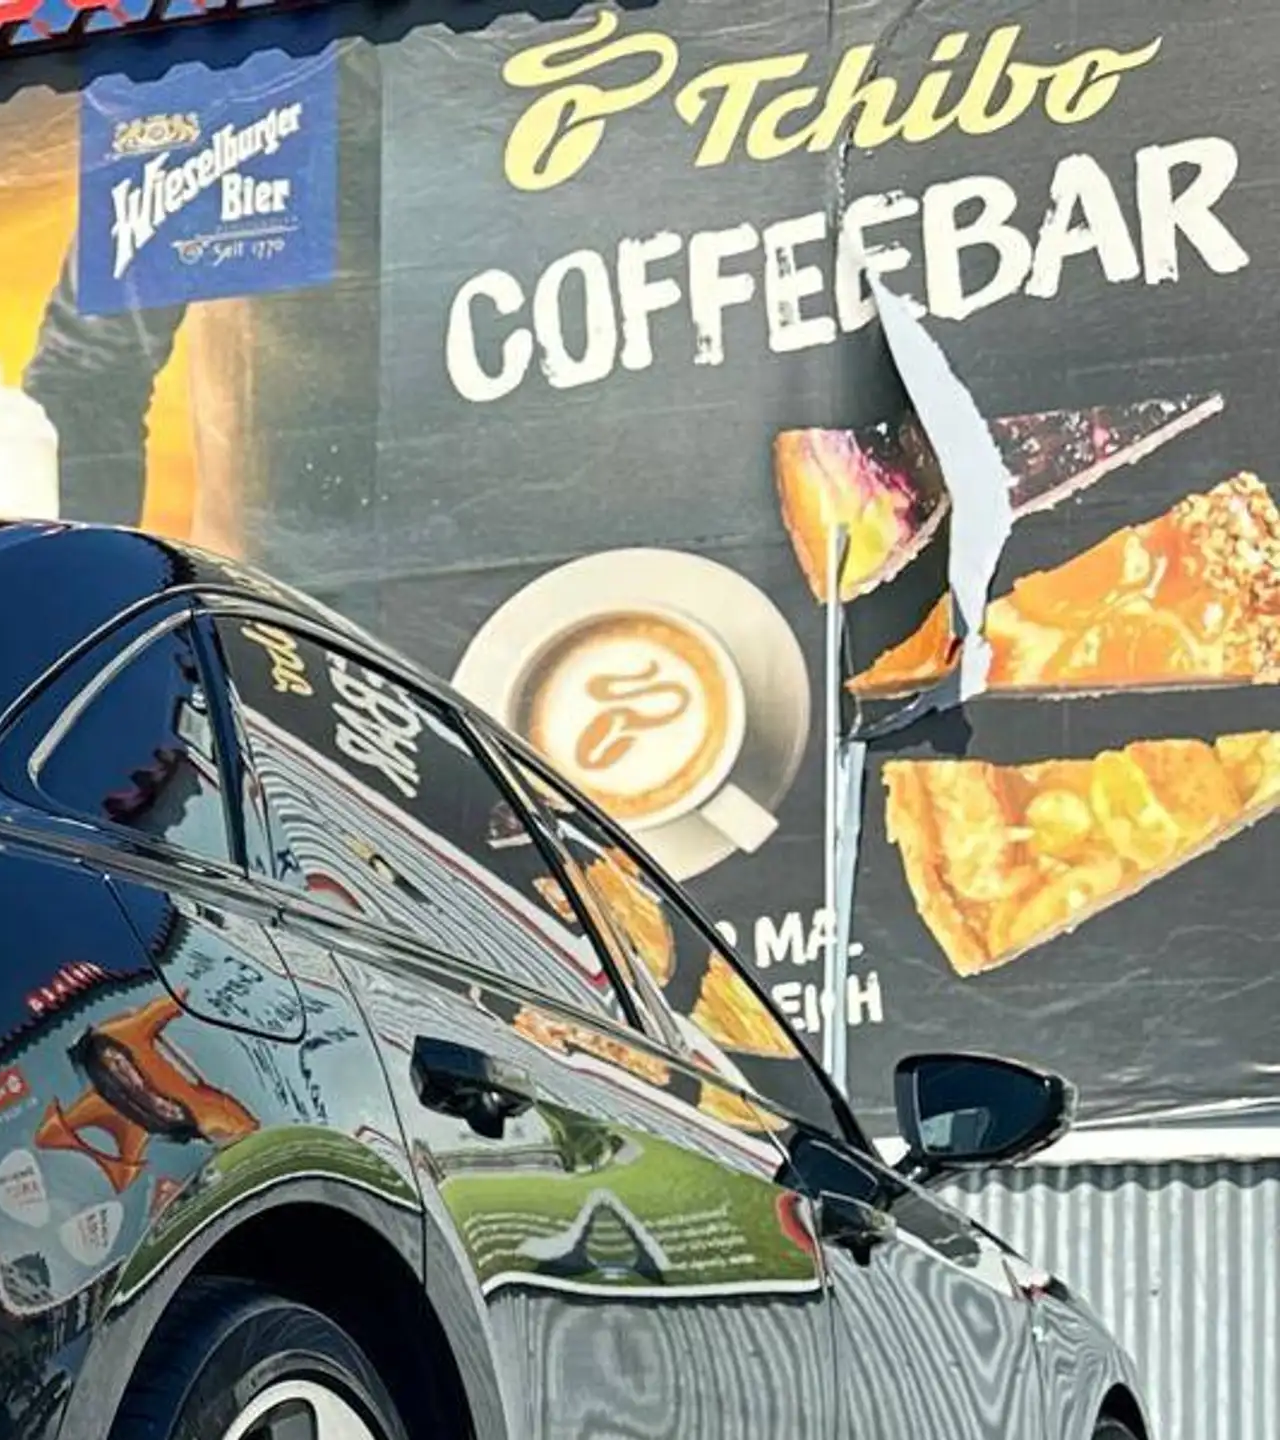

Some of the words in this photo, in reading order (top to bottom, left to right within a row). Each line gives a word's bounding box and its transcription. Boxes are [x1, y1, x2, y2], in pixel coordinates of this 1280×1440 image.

[676, 26, 1163, 168] Tchibo
[111, 102, 303, 280] Wieselburger
[220, 172, 290, 222] Bier
[446, 136, 1249, 402] COFFEEBAR
[772, 971, 883, 1033] EIH
